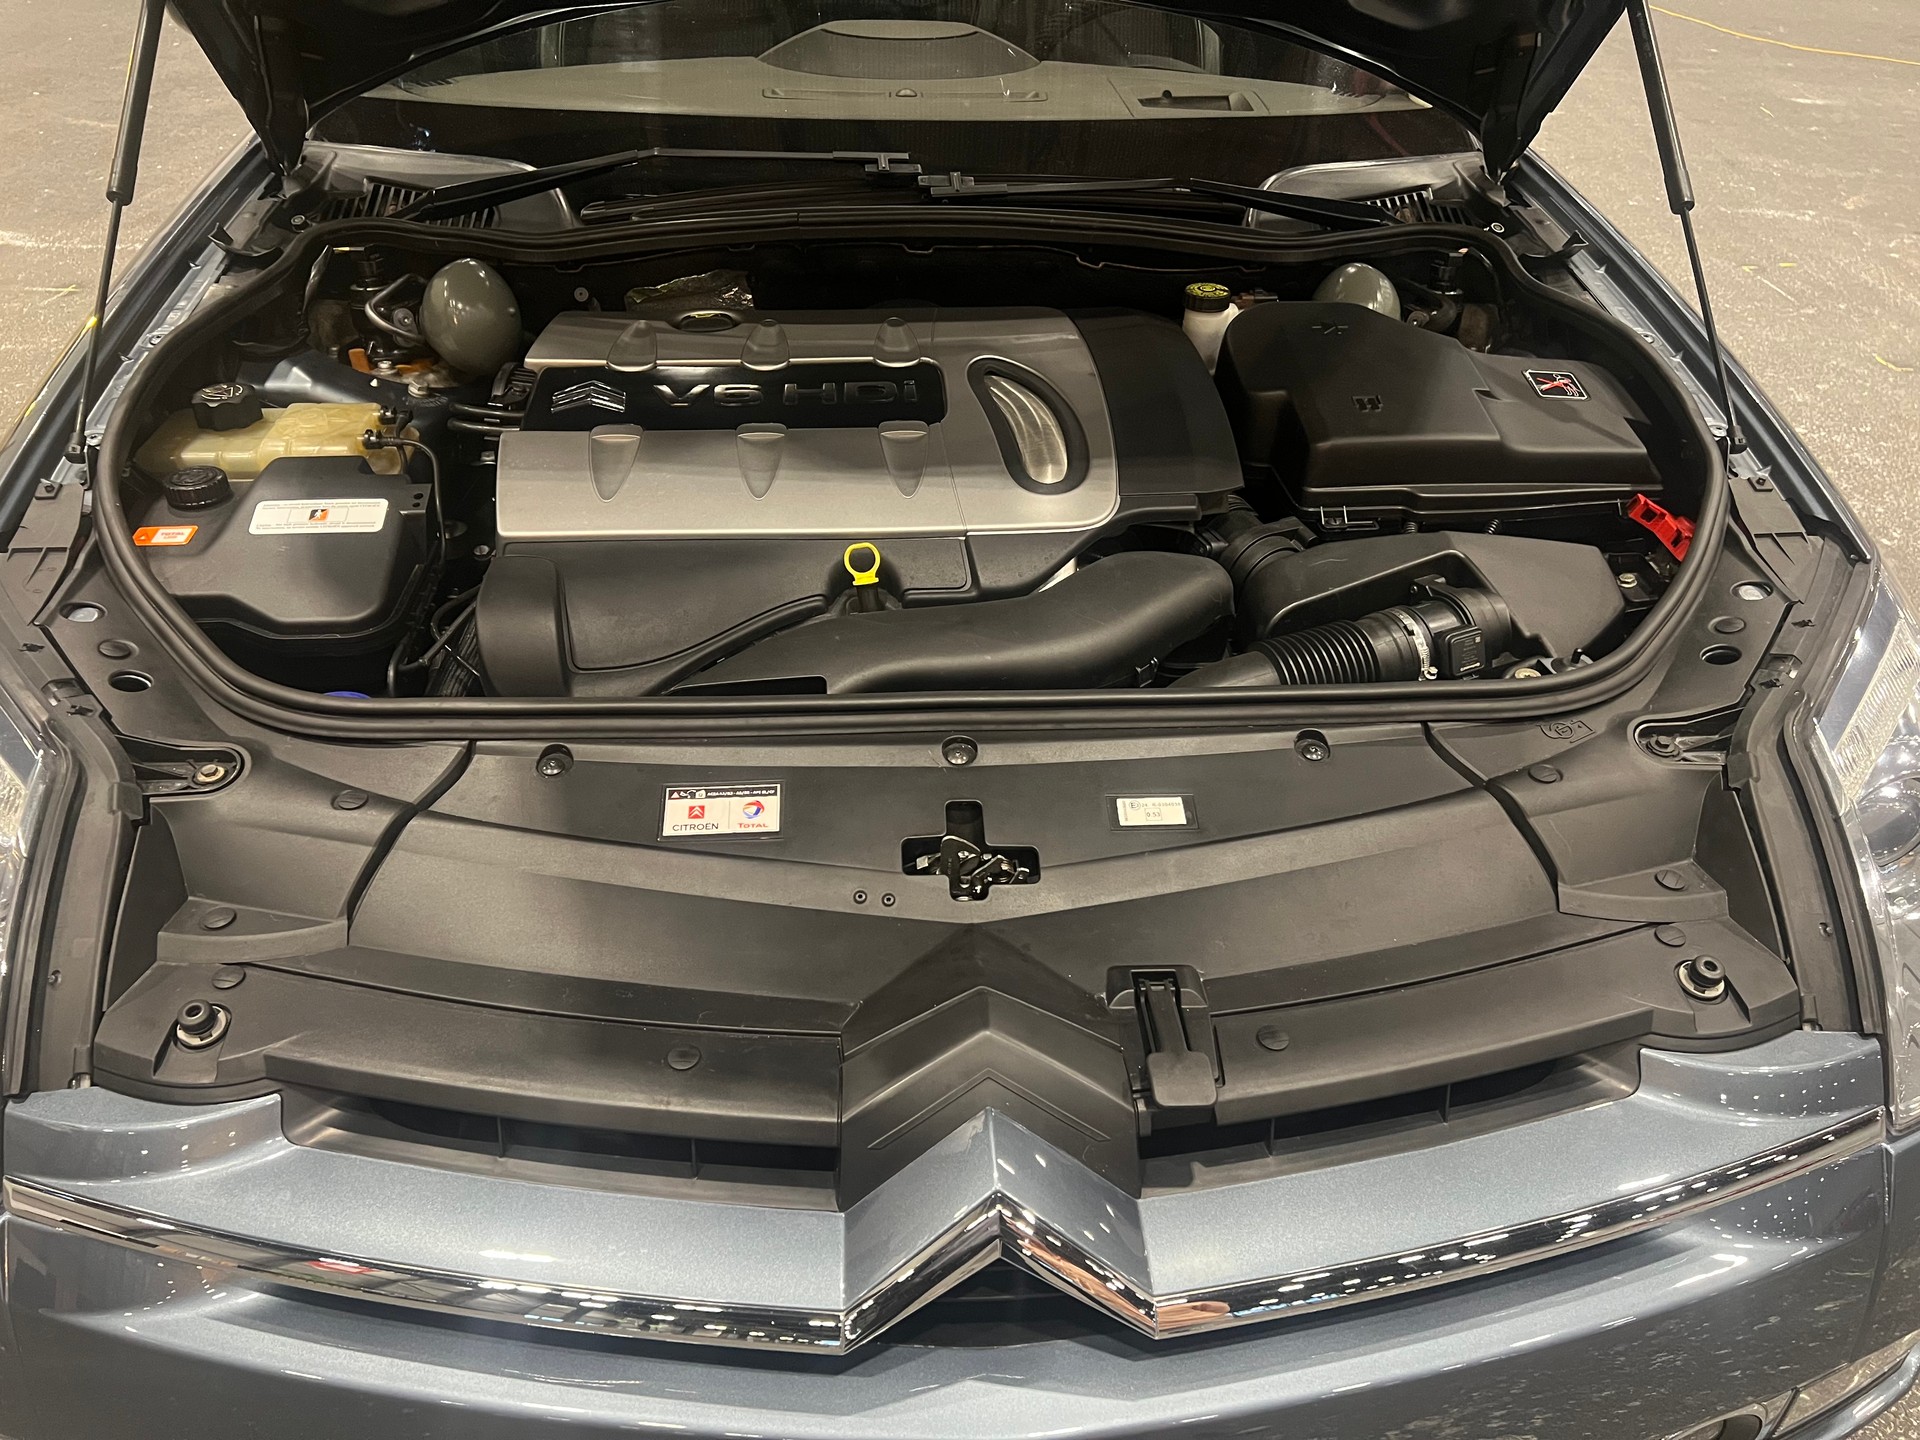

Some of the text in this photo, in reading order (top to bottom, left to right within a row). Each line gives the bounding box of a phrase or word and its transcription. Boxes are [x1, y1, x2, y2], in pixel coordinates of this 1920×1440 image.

[653, 380, 918, 406] V6 HDi
[672, 822, 719, 832] CITROËN
